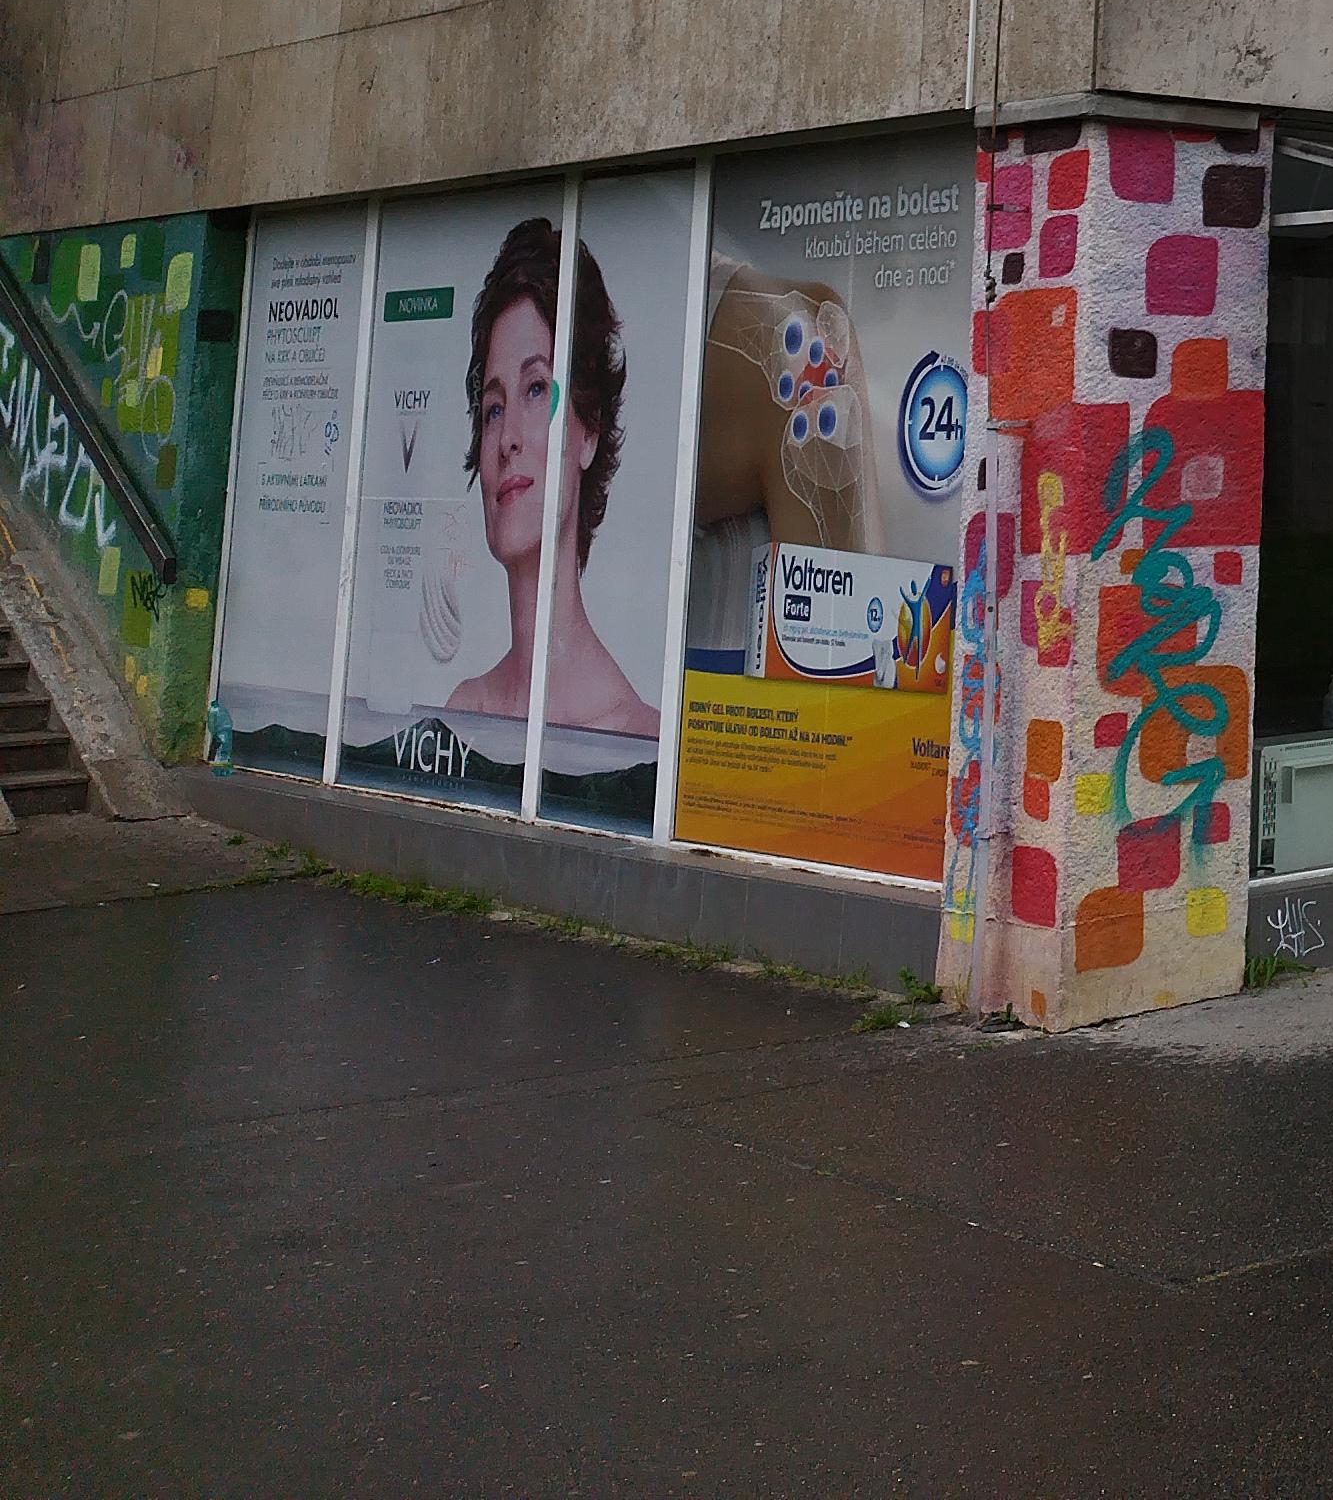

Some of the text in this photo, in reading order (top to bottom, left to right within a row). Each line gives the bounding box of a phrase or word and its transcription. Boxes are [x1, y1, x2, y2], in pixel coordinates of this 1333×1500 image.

[759, 183, 960, 235] Zapomeňte na bolest
[805, 224, 957, 258] kloubů během celého
[875, 264, 902, 288] dne
[905, 269, 914, 285] a
[268, 298, 338, 322] NEOVADIOL
[399, 298, 438, 314] NOVINKA
[394, 389, 431, 410] VICHY
[781, 553, 854, 597] Voltaren
[785, 598, 810, 618] Forte
[712, 703, 724, 715] GEL
[811, 732, 820, 744] 24
[393, 725, 474, 779] VICHY
